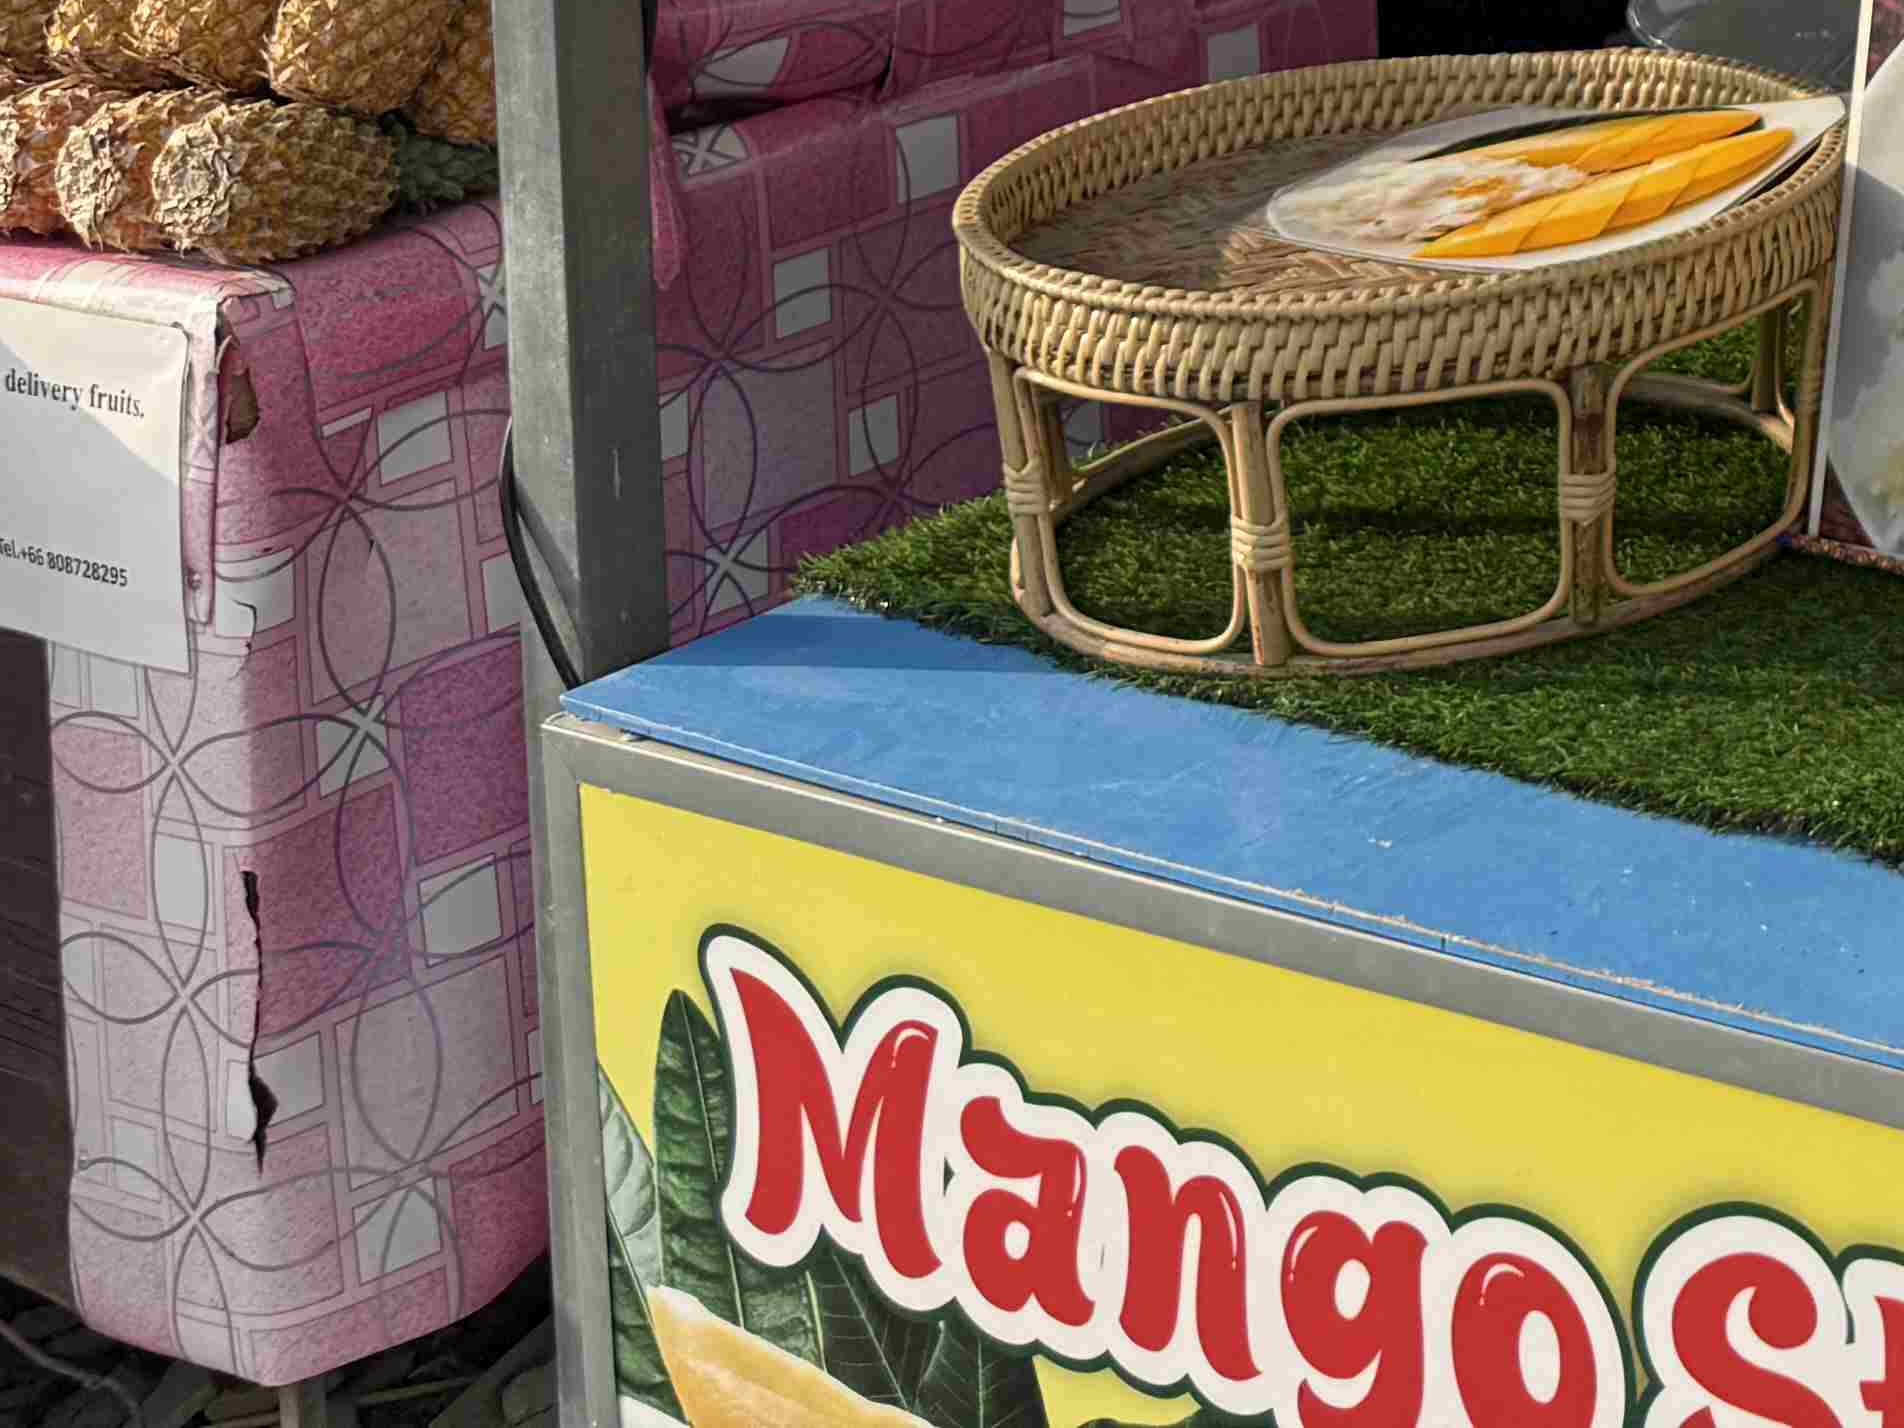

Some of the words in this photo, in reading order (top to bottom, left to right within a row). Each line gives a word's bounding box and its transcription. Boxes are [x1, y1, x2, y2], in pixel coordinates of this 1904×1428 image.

[4, 368, 83, 411] delivery
[89, 383, 145, 419] fruits.
[47, 550, 129, 588] 808728295
[731, 966, 1600, 1428] Mango
